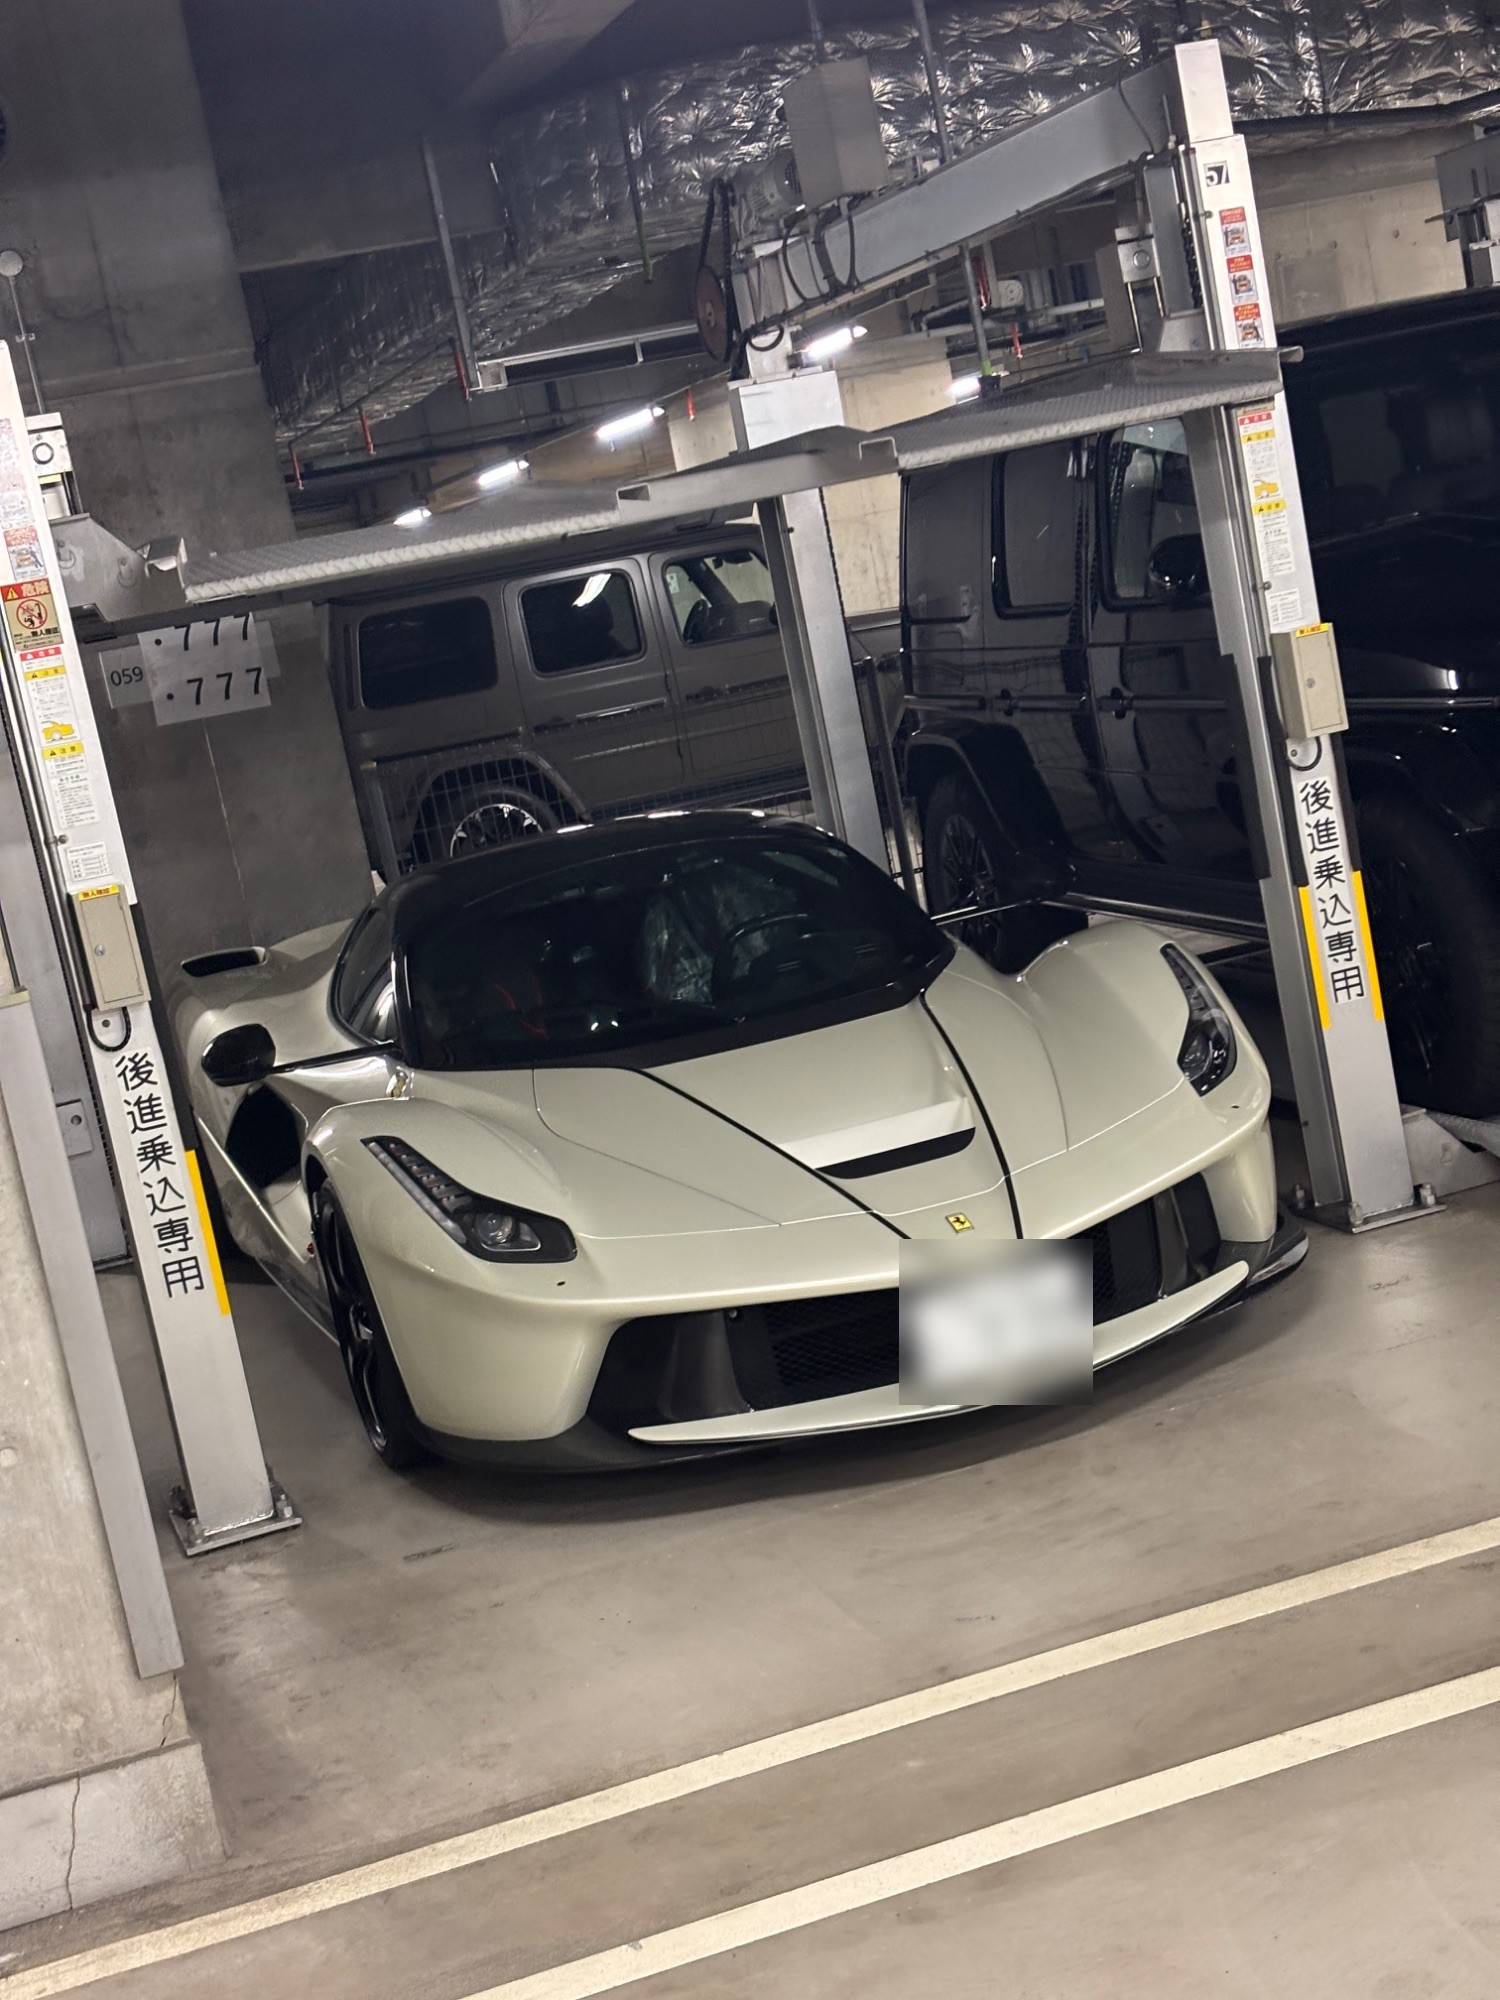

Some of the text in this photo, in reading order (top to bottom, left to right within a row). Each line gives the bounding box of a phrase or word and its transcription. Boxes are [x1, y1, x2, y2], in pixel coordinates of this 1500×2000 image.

[1205, 164, 1229, 187] 57
[110, 666, 144, 687] 059
[1300, 779, 1365, 1004] 後進乗込専用
[114, 1052, 205, 1299] 後進乗込専用
